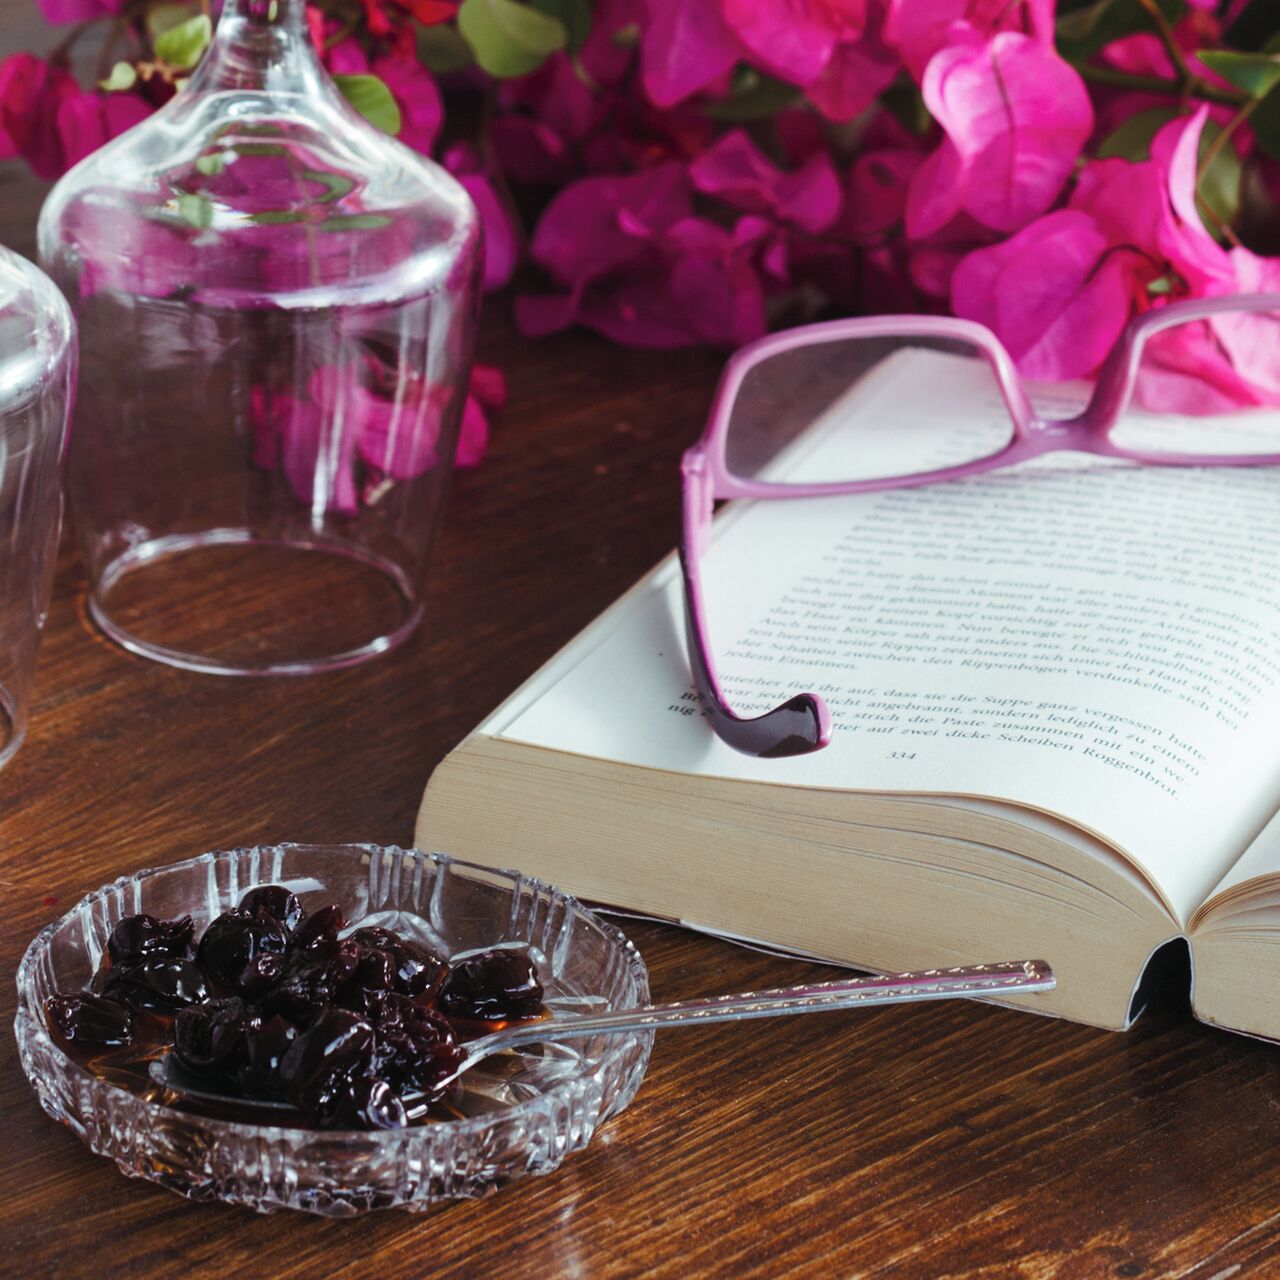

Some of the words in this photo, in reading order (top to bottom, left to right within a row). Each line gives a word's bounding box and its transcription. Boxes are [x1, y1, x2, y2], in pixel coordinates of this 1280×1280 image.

[666, 704, 697, 715] nig
[995, 733, 1074, 750] Scheiben
[980, 695, 1033, 707] Suppe
[1083, 708, 1162, 736] vergessen
[886, 751, 917, 761] 334
[969, 708, 1040, 719] sondern
[1046, 713, 1119, 734] lediglich
[1123, 733, 1146, 744] zu
[1150, 744, 1201, 776] einem
[990, 722, 1085, 739] zusammen
[1091, 737, 1122, 750] mit
[1127, 750, 1155, 765] ein
